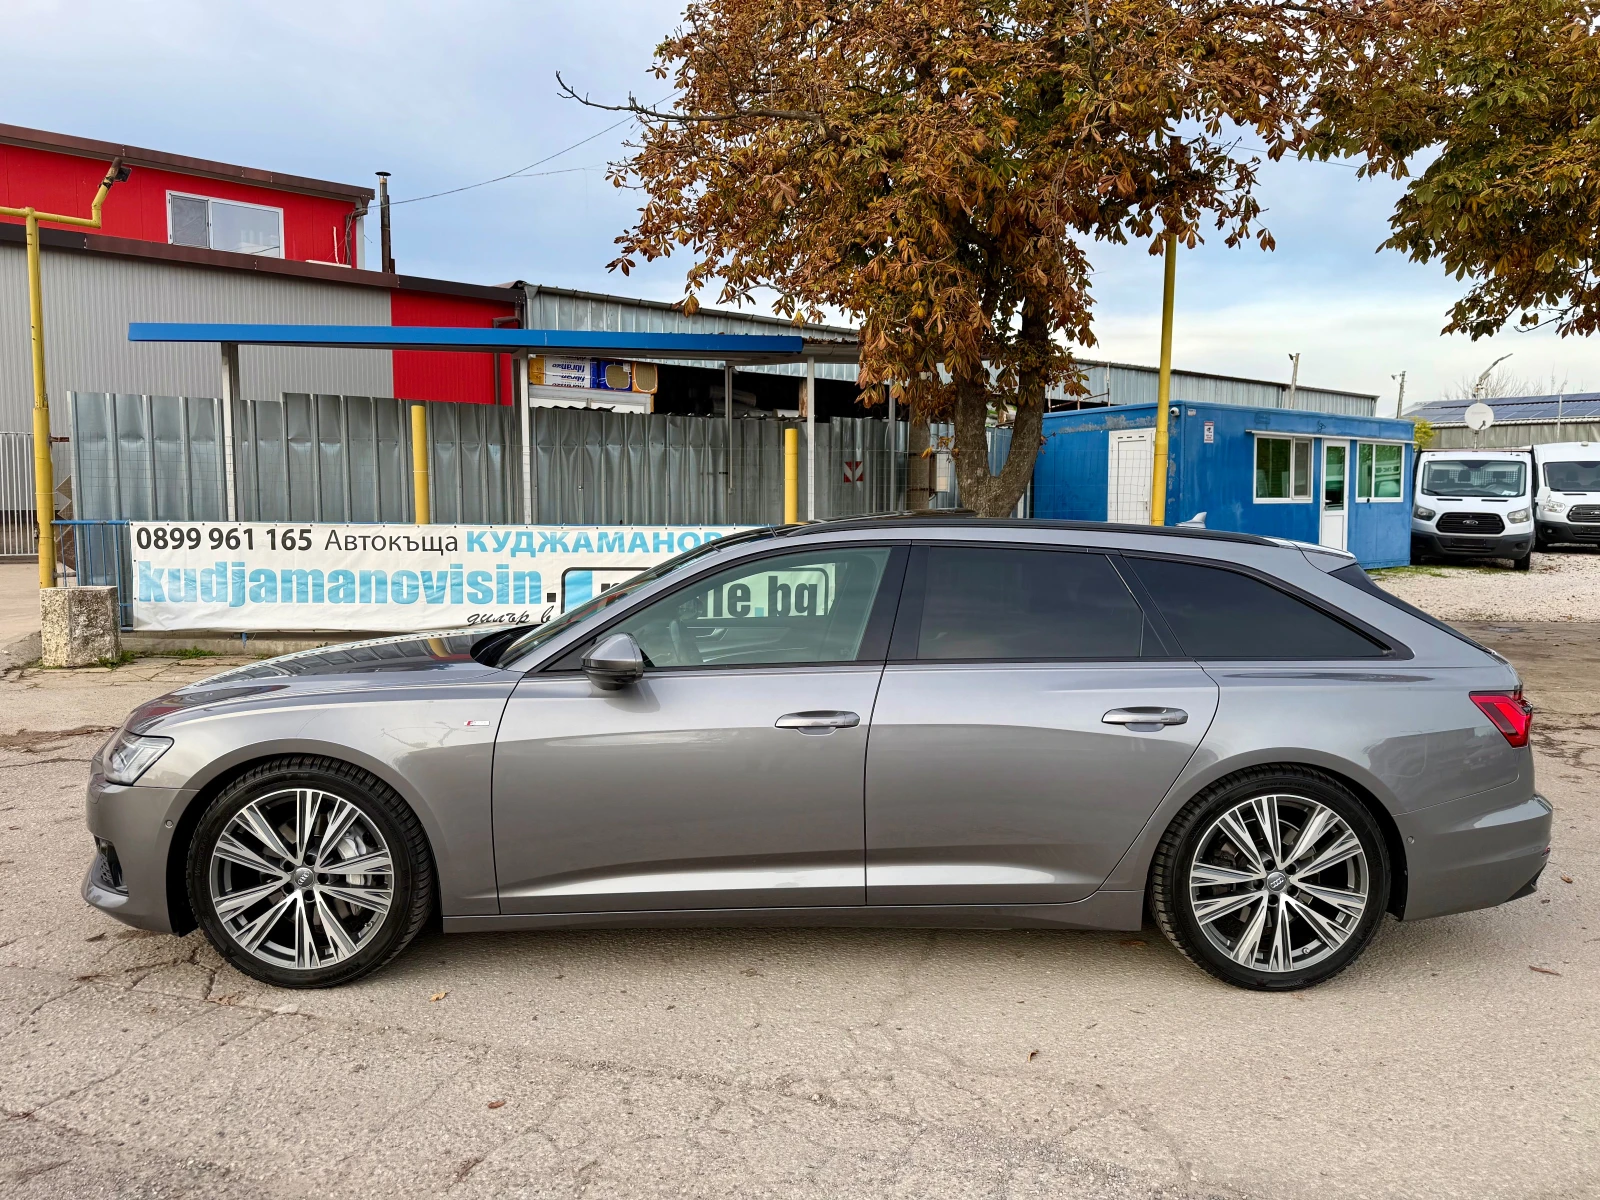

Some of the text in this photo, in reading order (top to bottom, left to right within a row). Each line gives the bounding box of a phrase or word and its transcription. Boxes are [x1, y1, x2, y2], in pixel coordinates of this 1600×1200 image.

[136, 527, 202, 551] 0899
[209, 527, 255, 551] 961
[266, 528, 313, 552] 165
[324, 529, 458, 556] Автокъща
[467, 610, 530, 626] дилър
